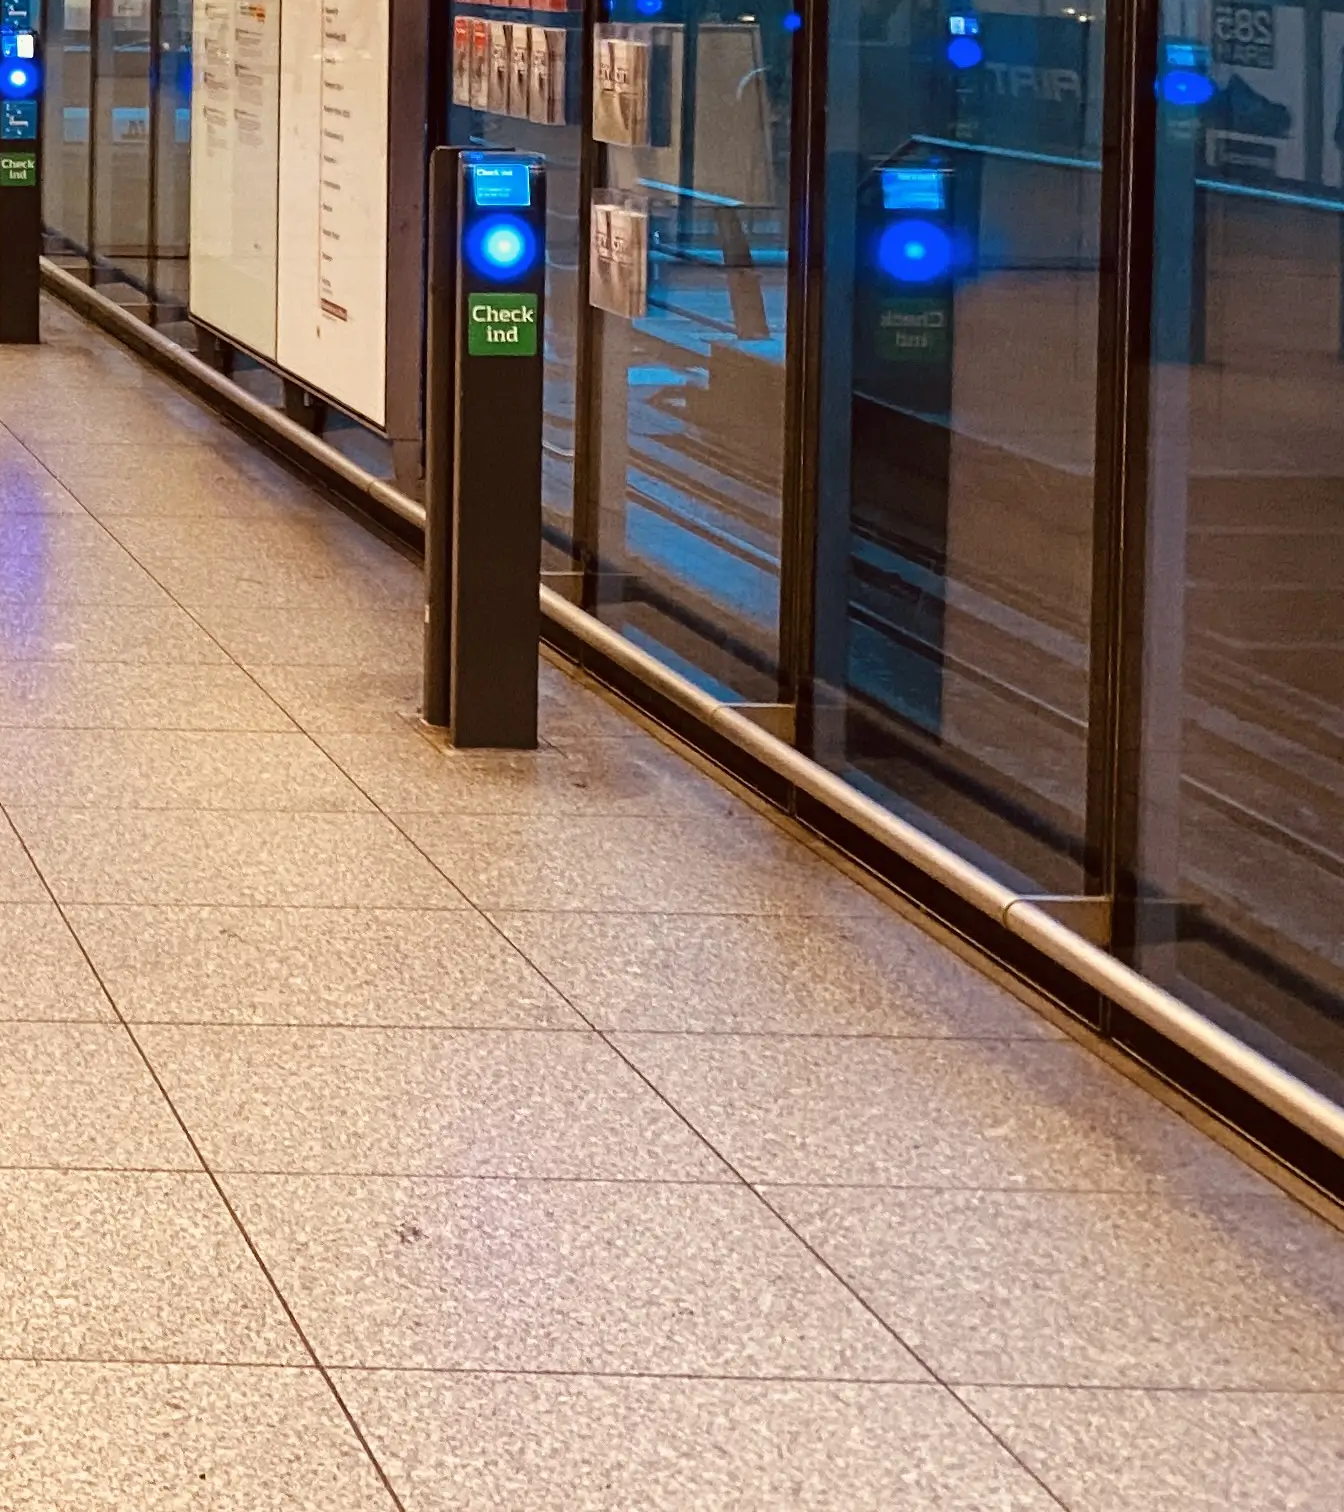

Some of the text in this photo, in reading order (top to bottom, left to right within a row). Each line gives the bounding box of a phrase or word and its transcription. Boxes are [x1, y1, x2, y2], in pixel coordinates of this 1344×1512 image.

[1, 159, 34, 169] Check
[9, 169, 27, 180] ind
[472, 305, 534, 323] Check
[486, 326, 519, 343] ind
